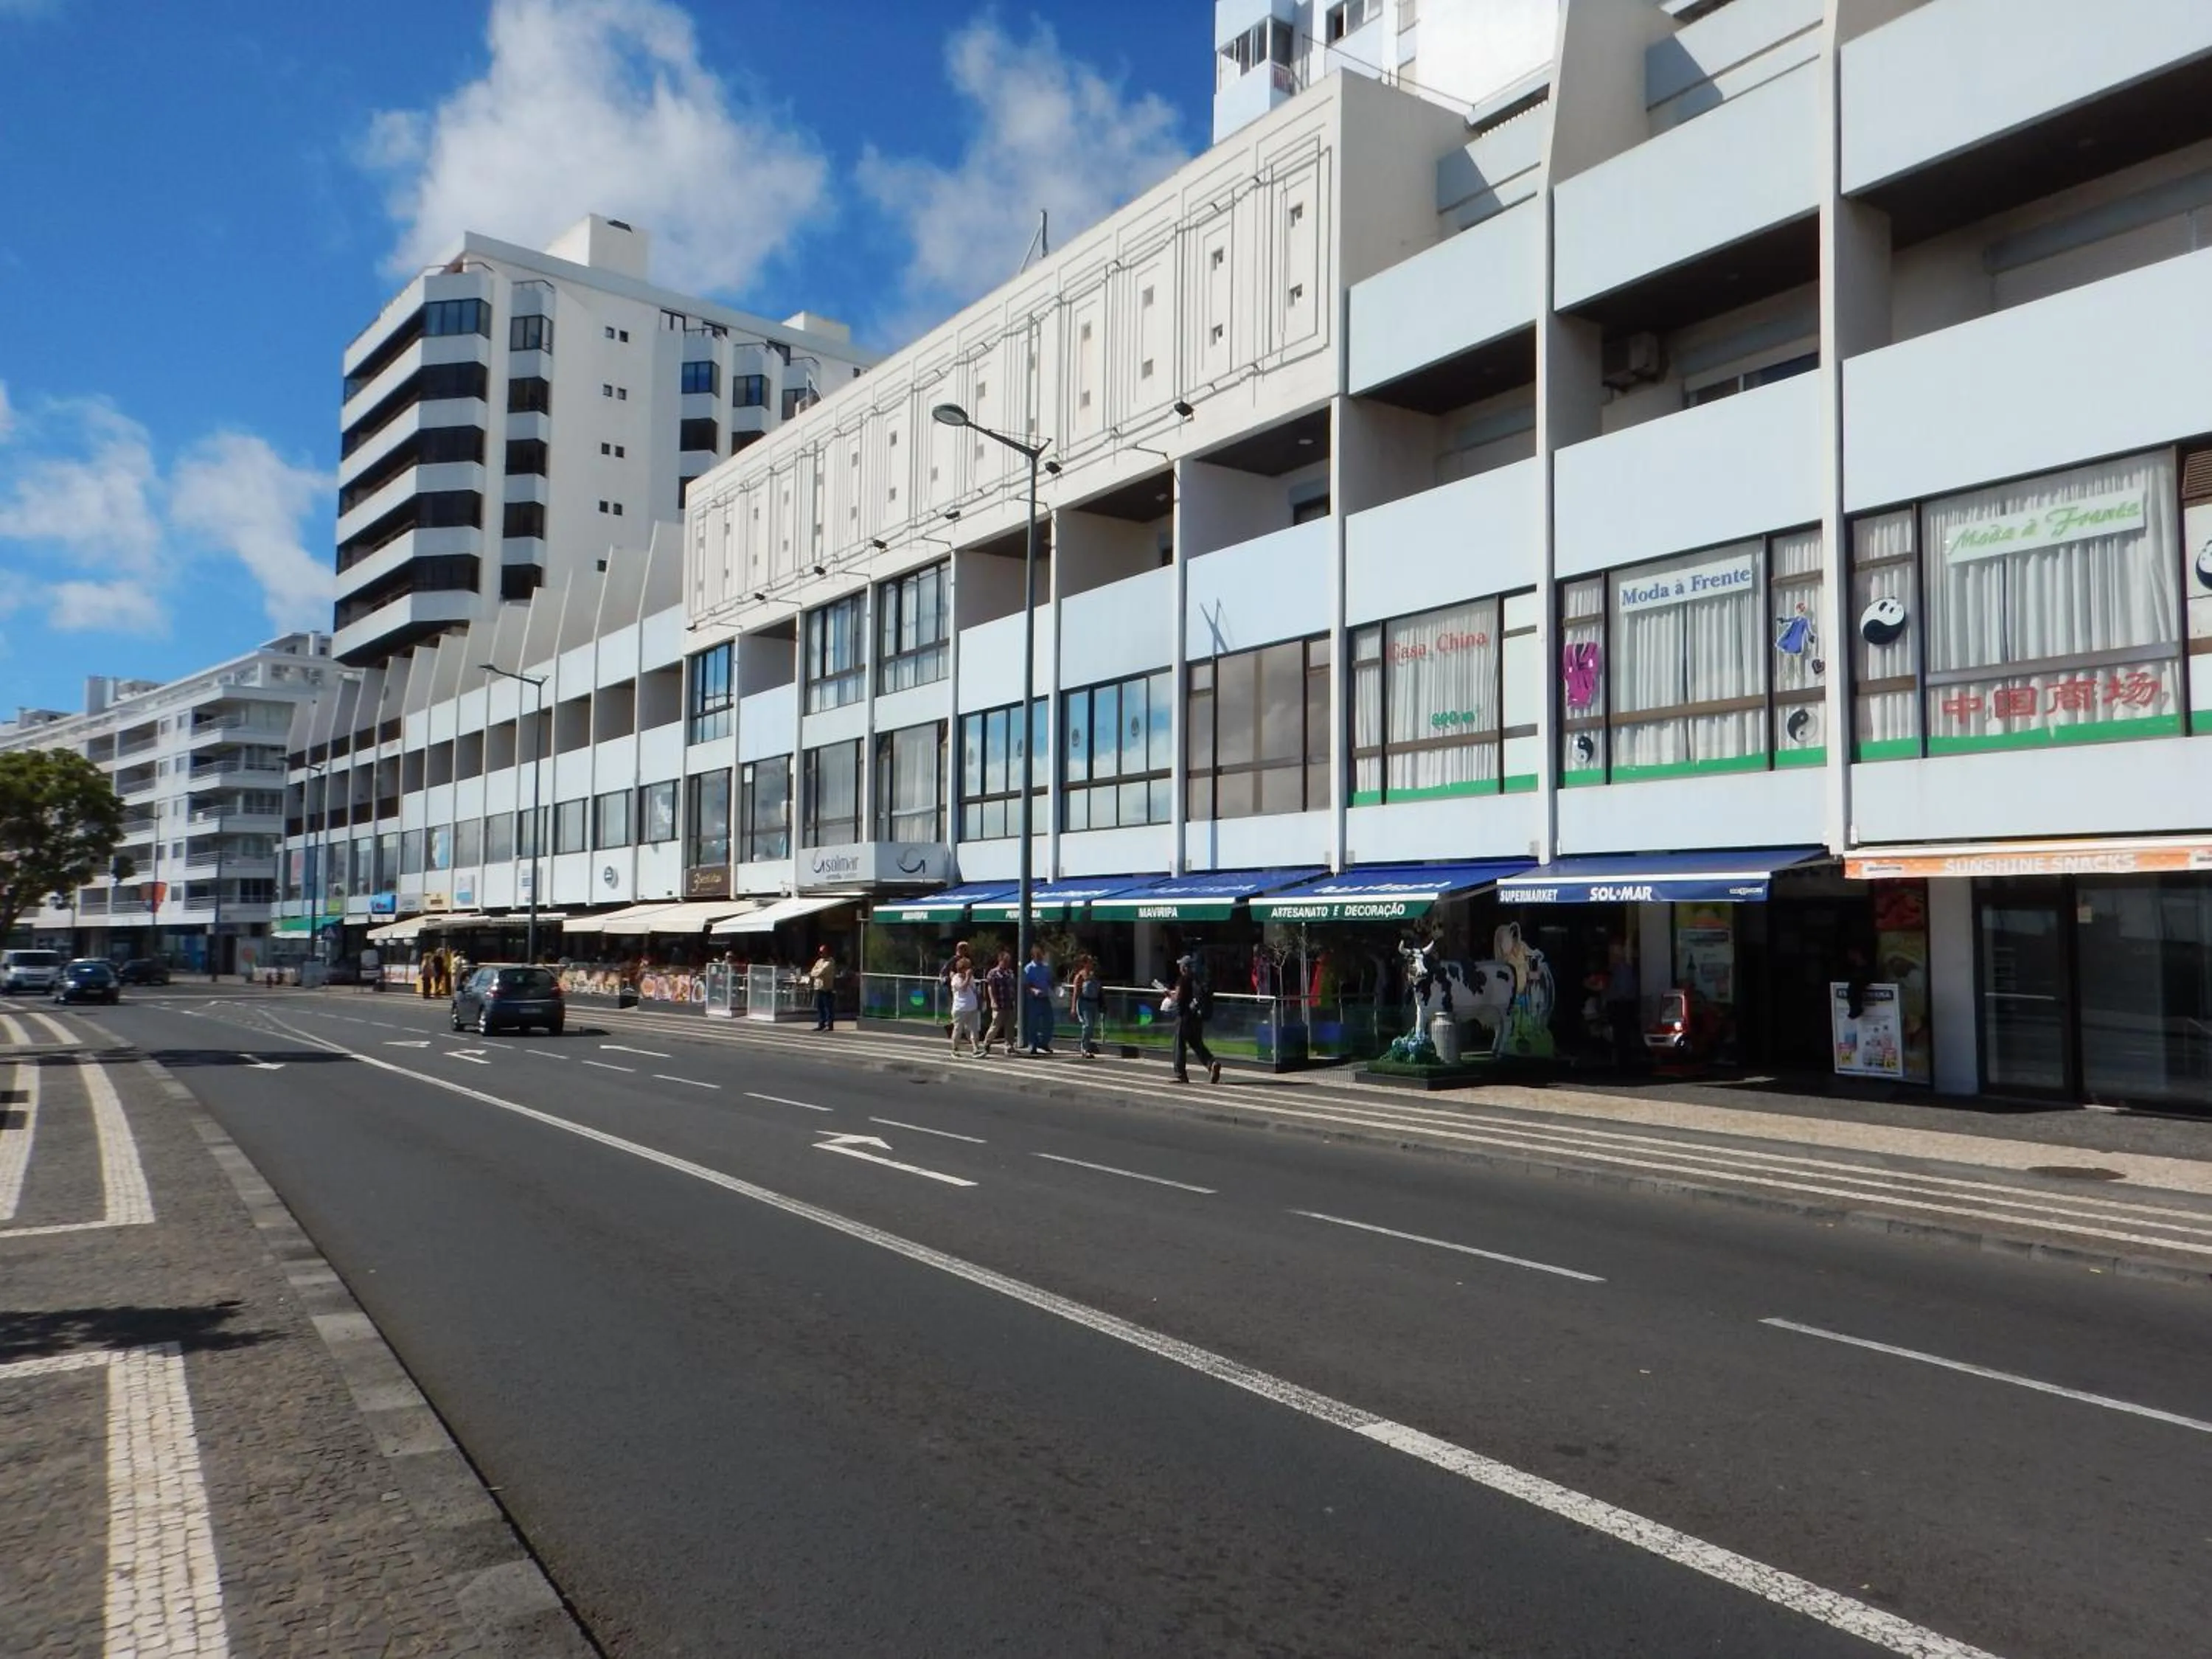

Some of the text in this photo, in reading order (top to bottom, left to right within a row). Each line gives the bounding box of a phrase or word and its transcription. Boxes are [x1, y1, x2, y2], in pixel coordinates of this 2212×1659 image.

[1621, 582, 1669, 605] Moda
[1690, 568, 1750, 592] Frente
[1437, 632, 1487, 652] China
[1941, 672, 2161, 725] 中国商场
[1944, 852, 2136, 874] SUNSHINE SNACKS
[1500, 888, 1558, 902] SUPERMARKET
[1270, 902, 1405, 918] ARTESANATO E DECORAÇÃO
